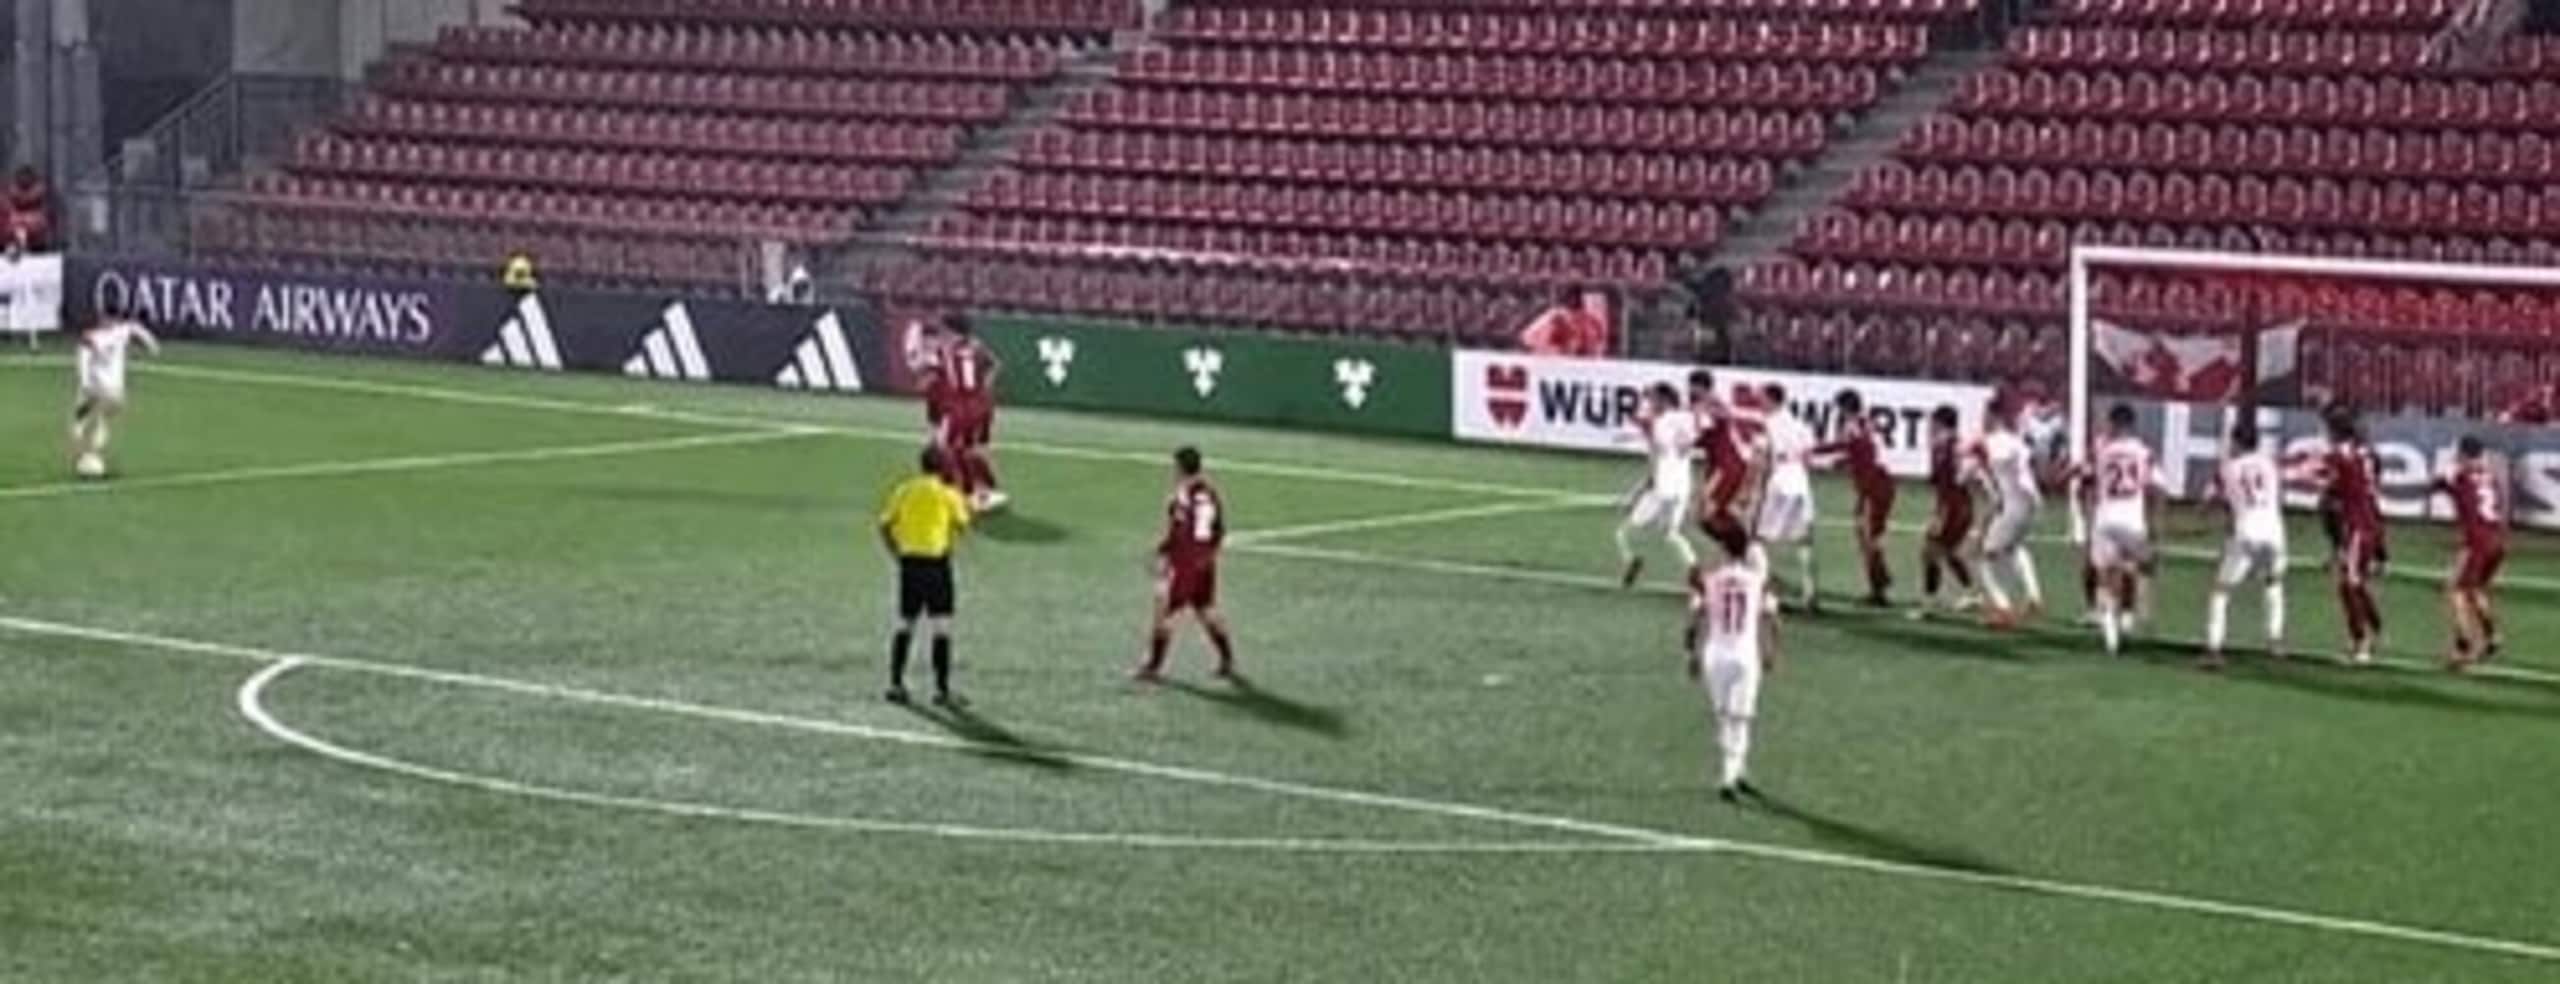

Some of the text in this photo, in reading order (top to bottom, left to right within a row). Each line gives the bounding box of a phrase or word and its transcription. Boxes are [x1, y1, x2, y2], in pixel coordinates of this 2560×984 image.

[95, 271, 432, 342] QATAR AIRWAYS
[1538, 380, 1652, 427] WÜR
